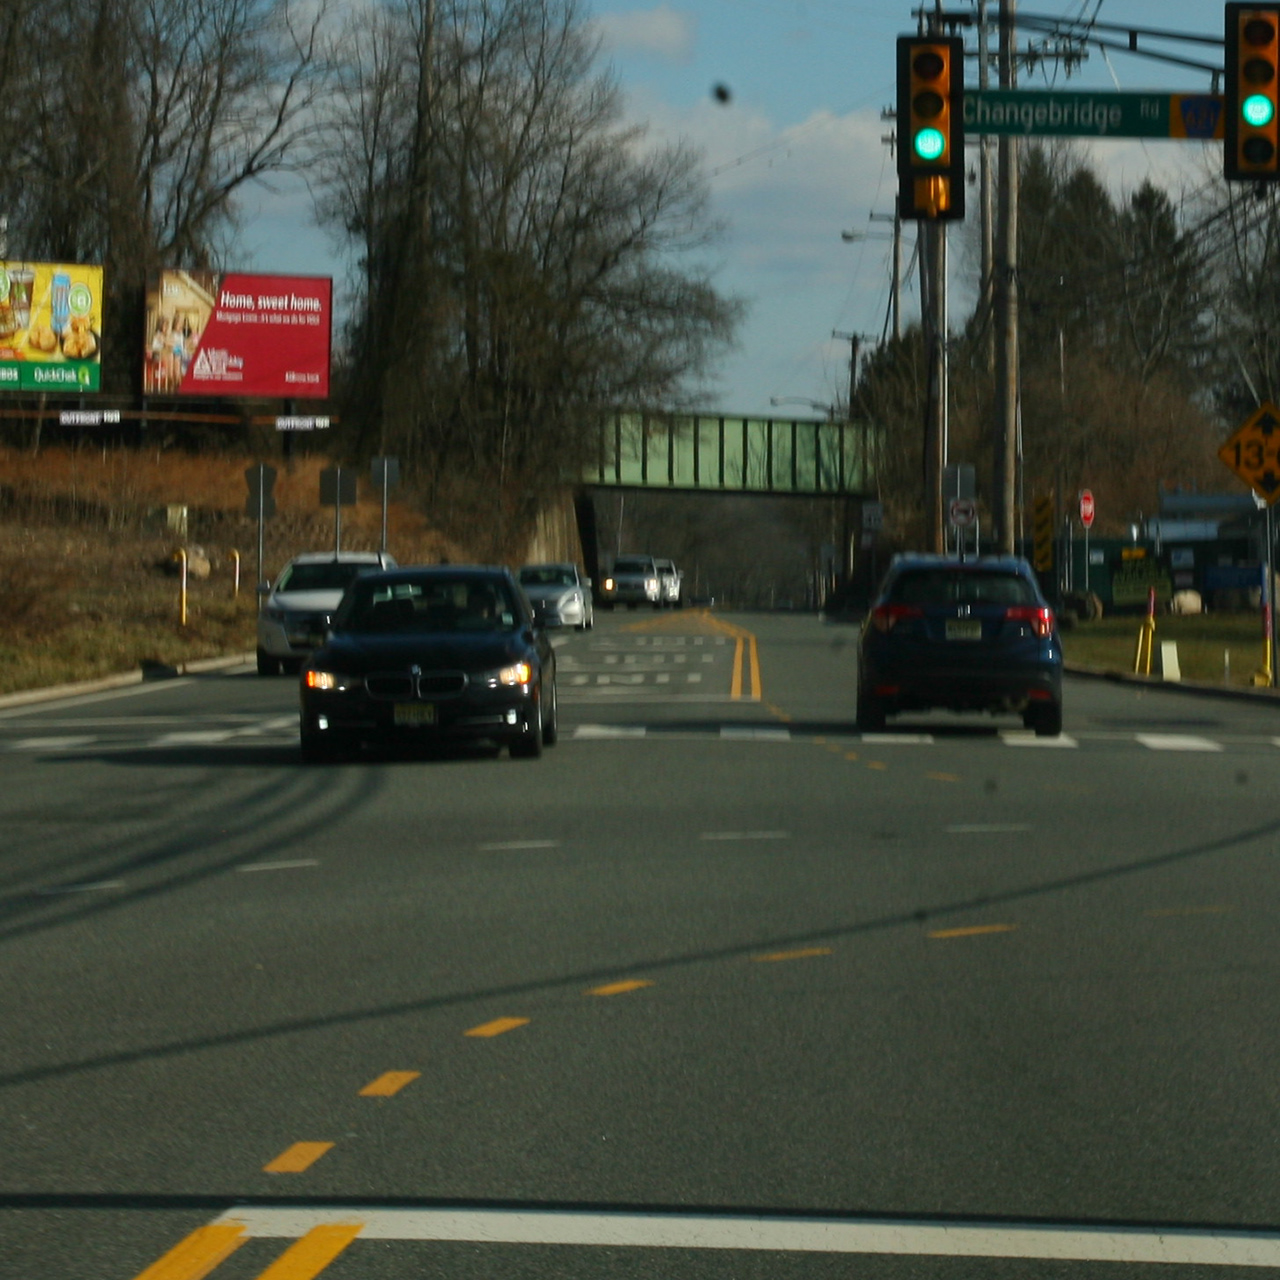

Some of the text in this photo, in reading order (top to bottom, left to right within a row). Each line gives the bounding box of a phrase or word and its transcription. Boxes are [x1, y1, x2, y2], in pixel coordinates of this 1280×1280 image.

[962, 95, 1161, 135] Changebridge Rd
[220, 290, 255, 312] Home,
[257, 294, 288, 311] sweet
